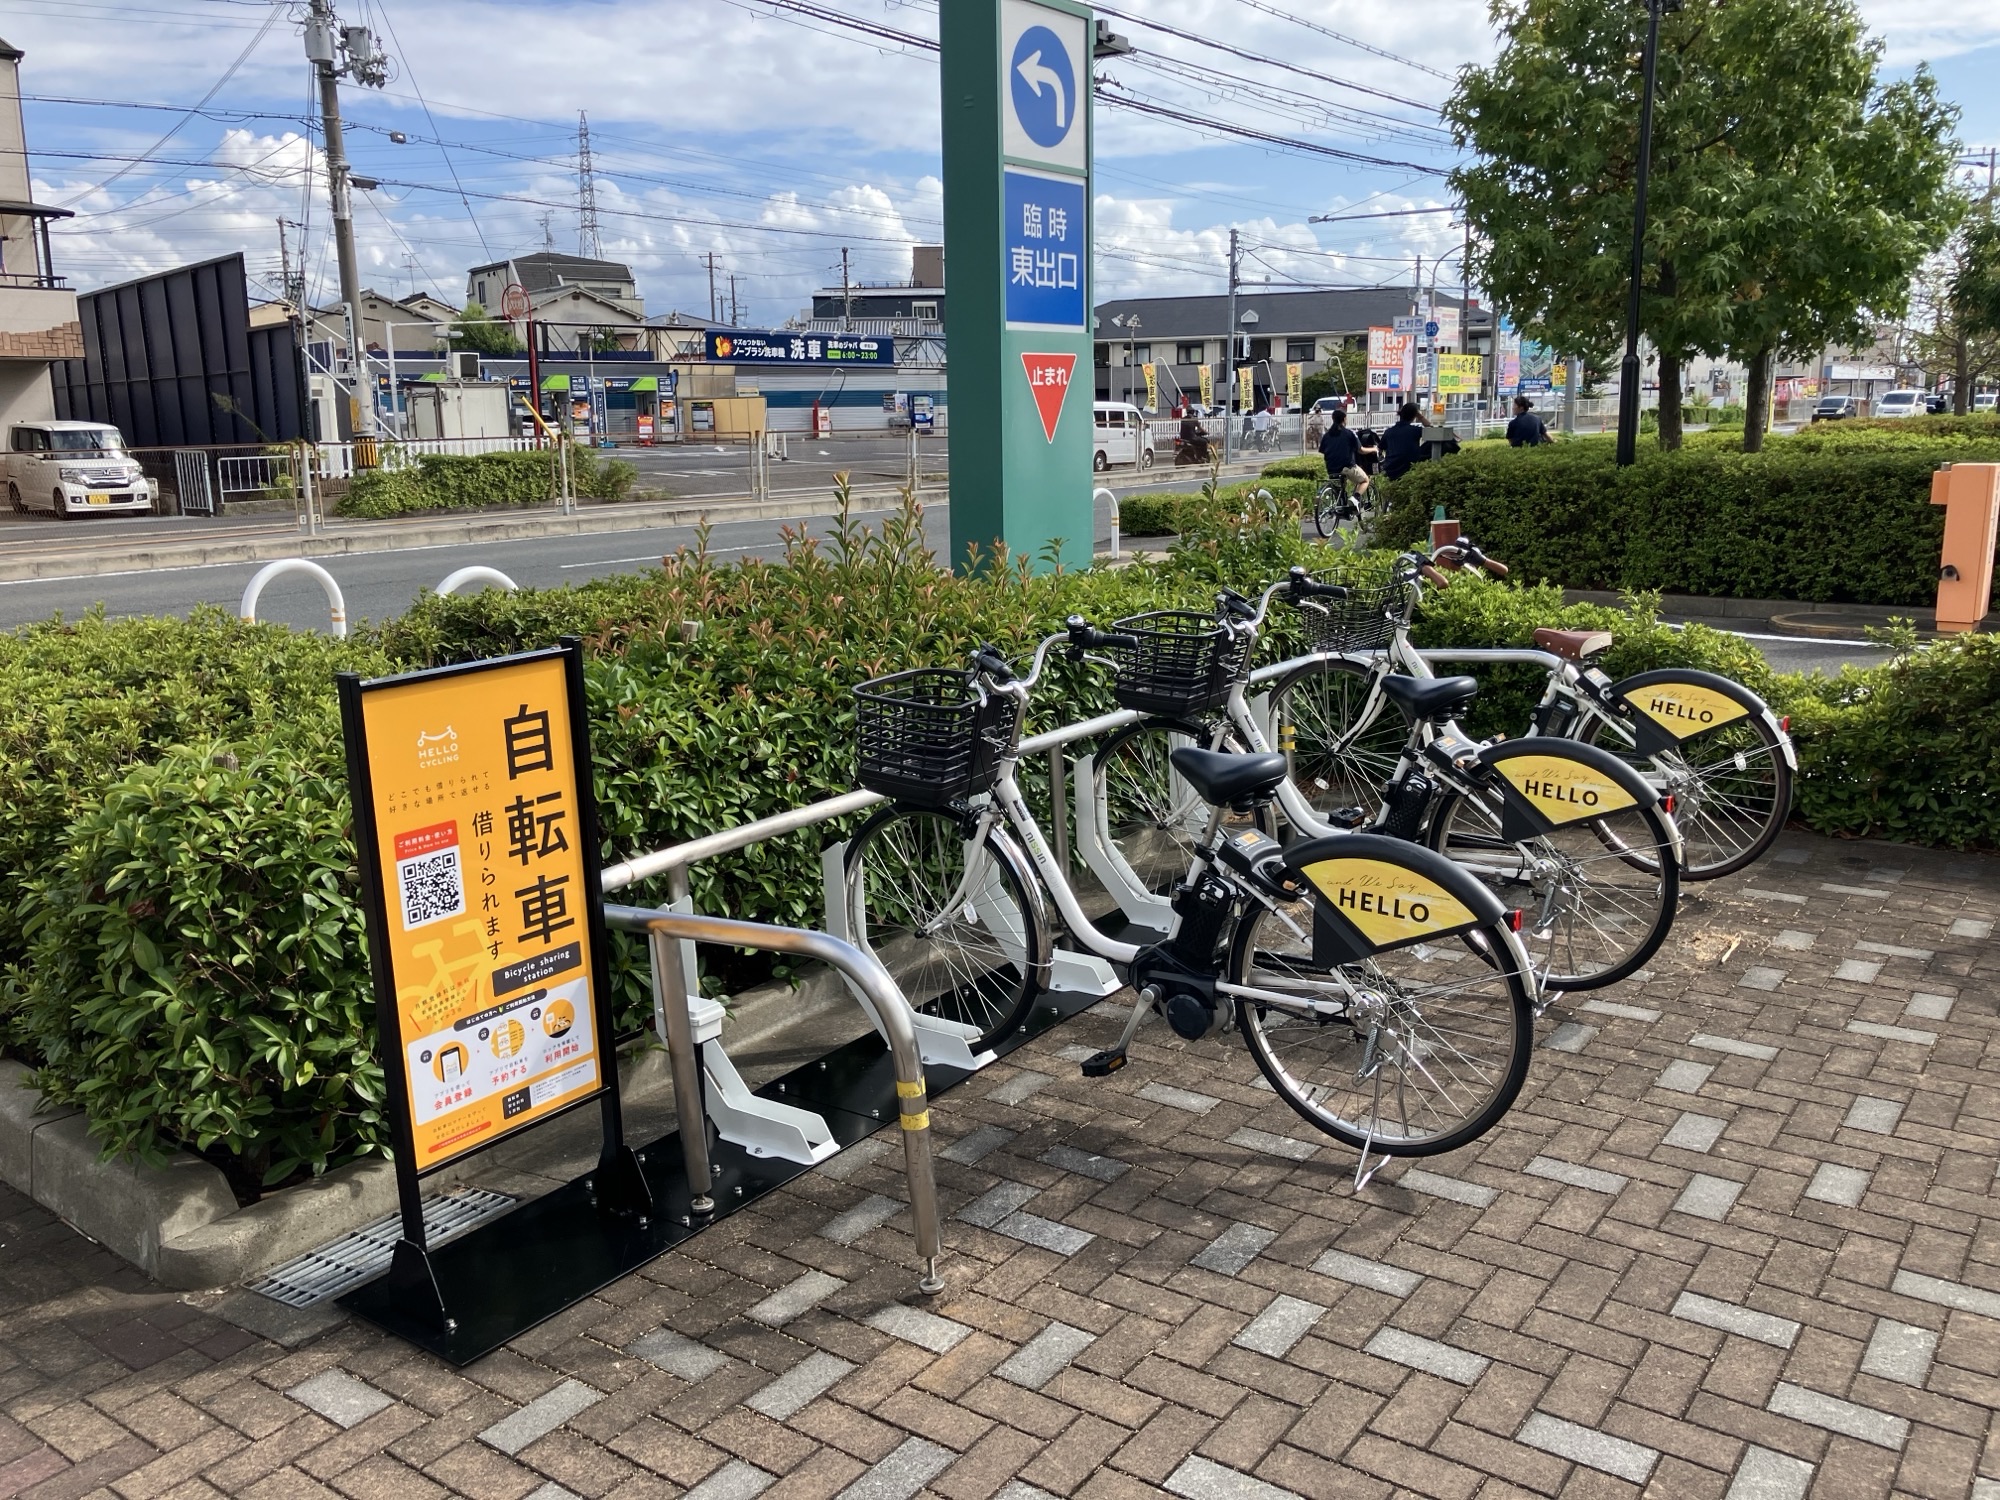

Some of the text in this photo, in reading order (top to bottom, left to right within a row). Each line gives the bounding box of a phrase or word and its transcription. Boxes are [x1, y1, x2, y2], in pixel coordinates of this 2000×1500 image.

[1022, 203, 1068, 242] 臨時
[1011, 245, 1078, 291] 東出口
[1426, 325, 1437, 333] 30
[732, 338, 767, 346] キズのつかない
[732, 346, 786, 358] ノーブラシ洗車機
[790, 338, 822, 360] 洗車
[1032, 365, 1068, 387] 止まれ
[1650, 699, 1713, 724] HELLO
[418, 742, 458, 759] HELLO
[419, 754, 459, 769] CYCLING
[388, 771, 489, 802] どこでも借りられて
[1524, 779, 1599, 807] HELLO
[389, 783, 490, 814] 好きな場所で返せる
[503, 704, 575, 945] 自転車
[1025, 831, 1047, 864] nissin
[472, 809, 504, 961] 借りられます
[1326, 874, 1418, 894] and We Say
[1339, 888, 1430, 923] HELLO
[504, 950, 571, 979] Bicycle sharing
[523, 966, 554, 983] station
[466, 1010, 498, 1025] はじめての方へ
[545, 1043, 579, 1064] 利用開始
[491, 1064, 527, 1086] 予約する
[434, 1087, 473, 1110] 会員登録
